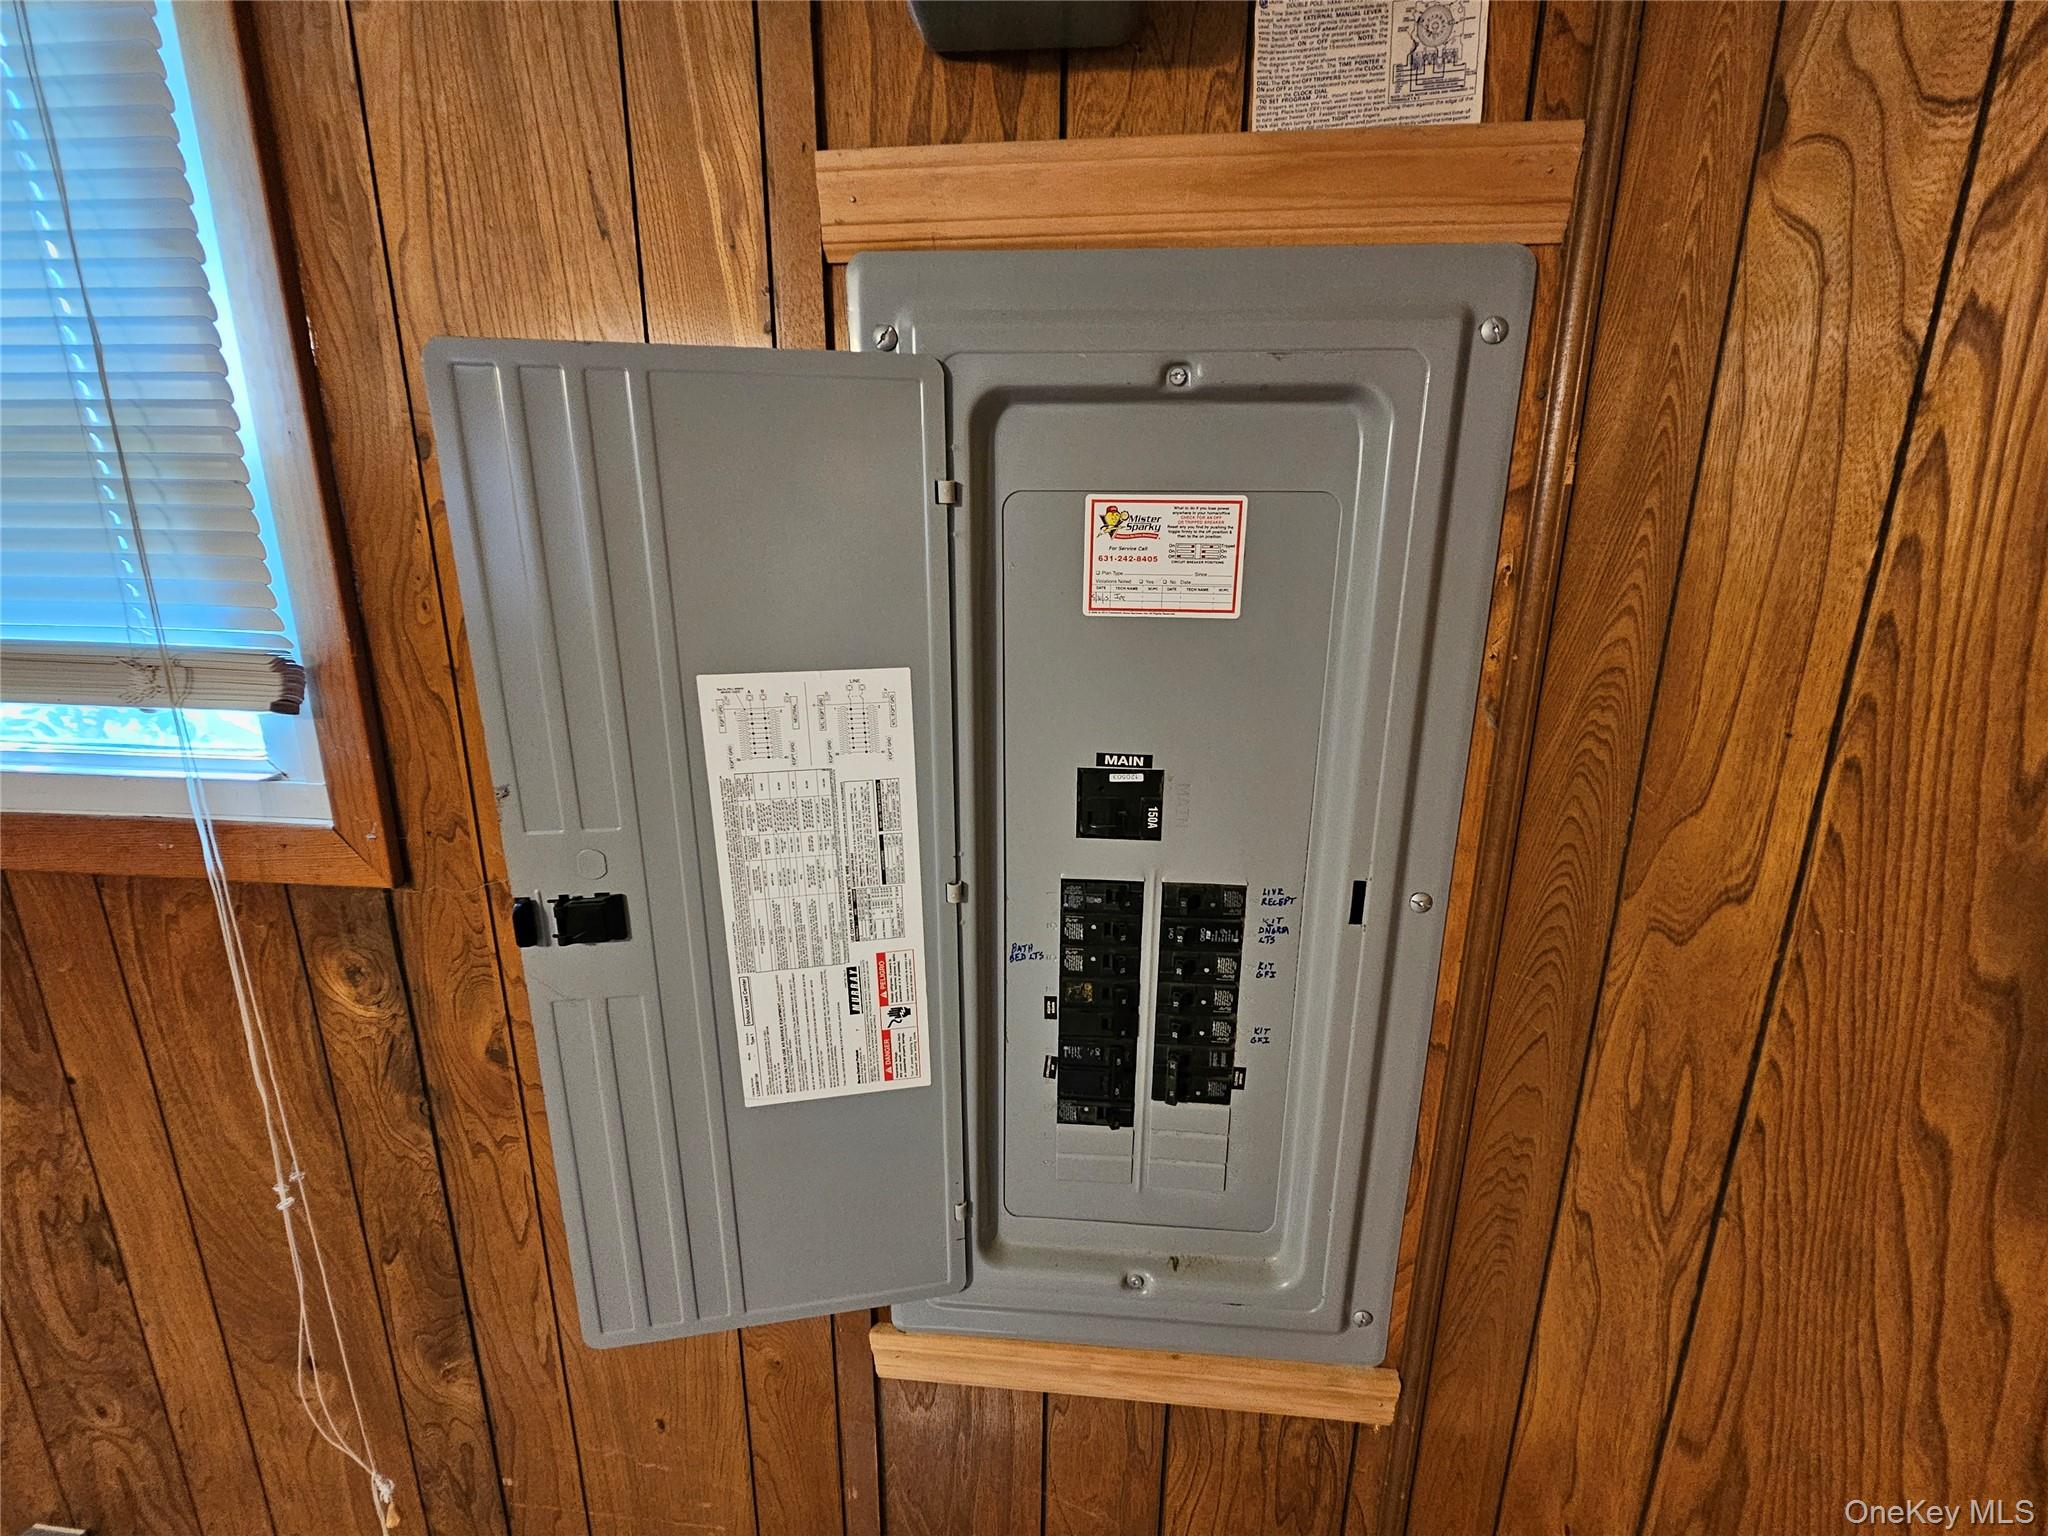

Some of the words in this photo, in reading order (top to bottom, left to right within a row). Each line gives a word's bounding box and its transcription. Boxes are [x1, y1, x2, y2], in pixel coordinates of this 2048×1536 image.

[1128, 515, 1162, 523] Mister
[1126, 522, 1161, 532] Sparky
[1098, 555, 1158, 563] 631-242-8405
[1104, 754, 1144, 766] MAIN
[1147, 806, 1159, 829] 150A
[1011, 942, 1034, 954] BATH
[1009, 952, 1027, 963] BED
[1258, 961, 1275, 970] KIT
[878, 960, 886, 990] PELIGRO
[1256, 970, 1277, 979] GFI
[848, 969, 860, 1011] MURRAY
[1254, 1027, 1271, 1035] KIT
[1250, 1036, 1270, 1044] GFI
[883, 1038, 892, 1065] DANGER
